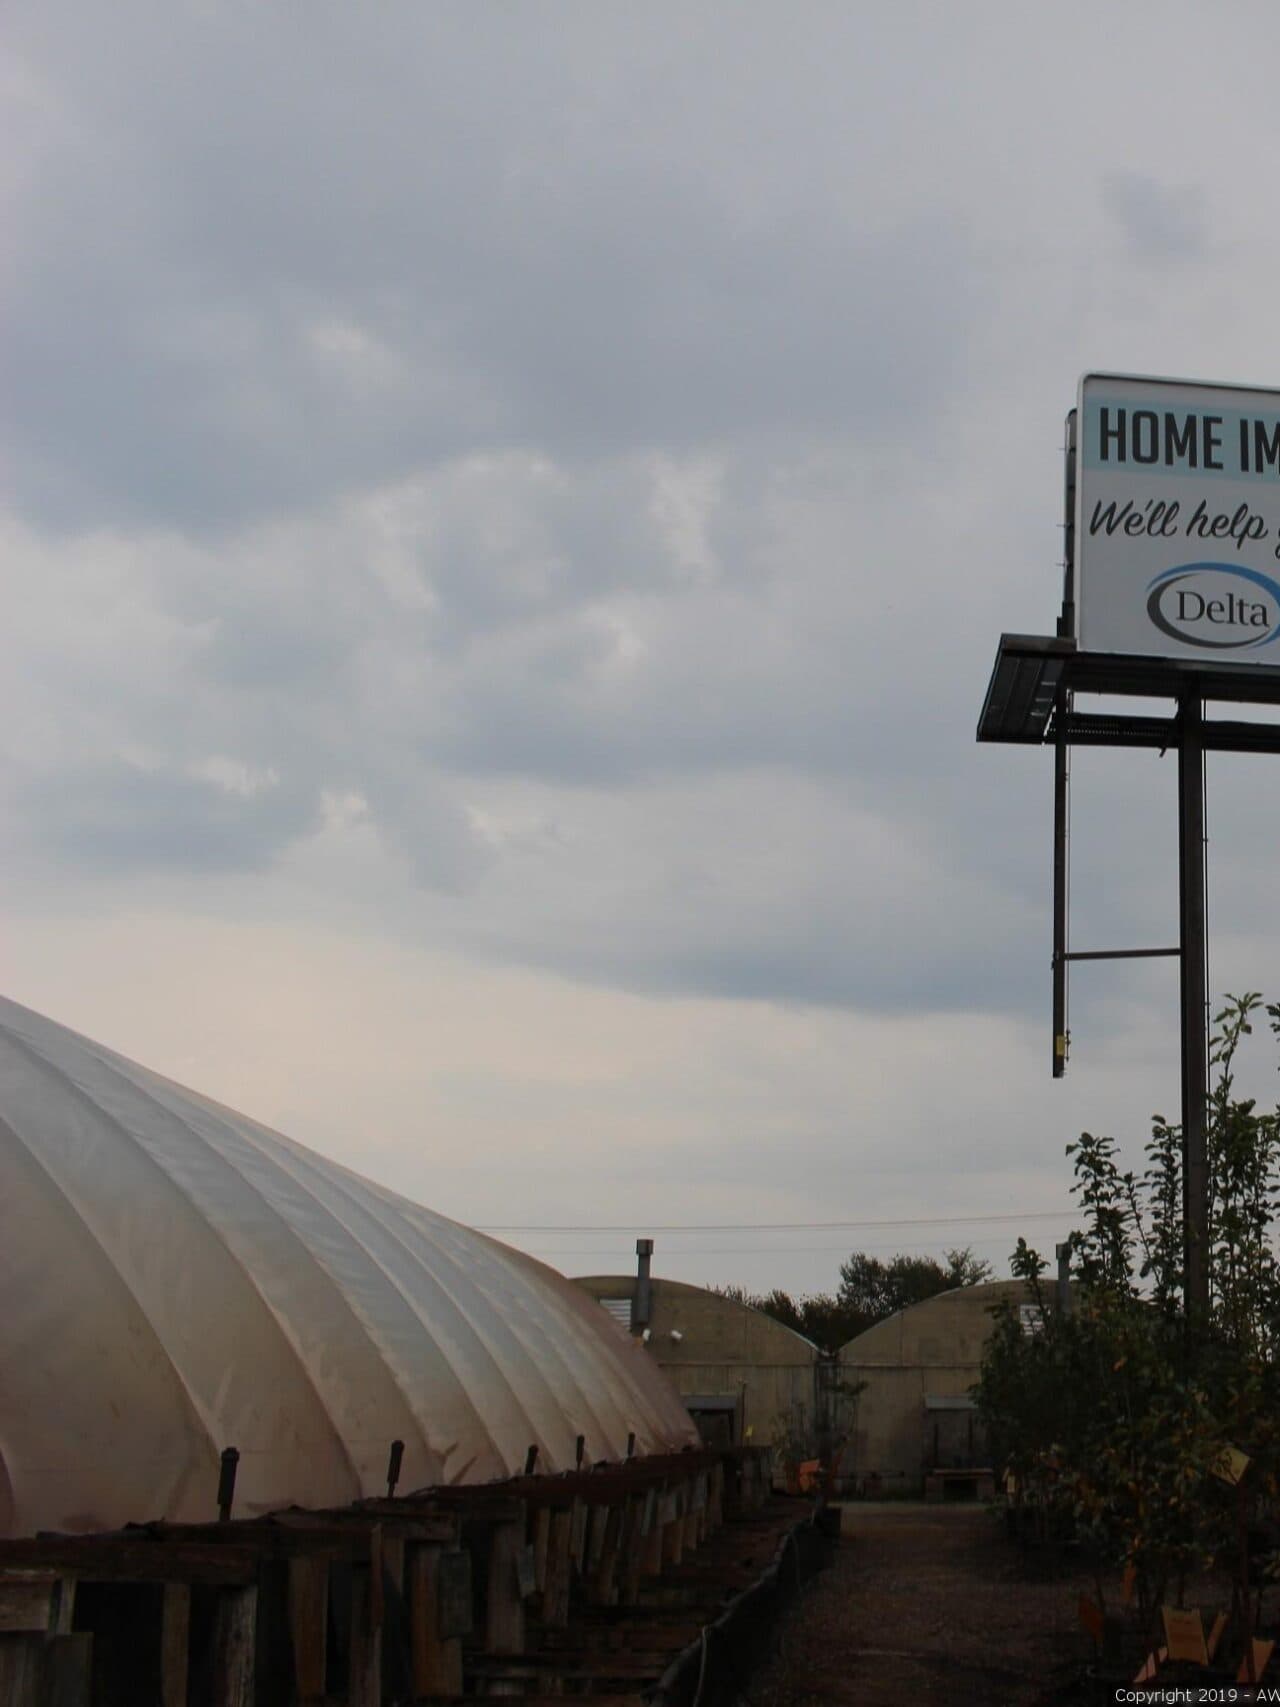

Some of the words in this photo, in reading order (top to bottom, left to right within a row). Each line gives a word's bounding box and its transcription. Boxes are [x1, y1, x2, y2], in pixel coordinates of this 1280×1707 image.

[1100, 407, 1224, 470] HOME
[1089, 499, 1180, 537] We'll
[1186, 499, 1268, 550] help
[1175, 591, 1270, 628] Delta
